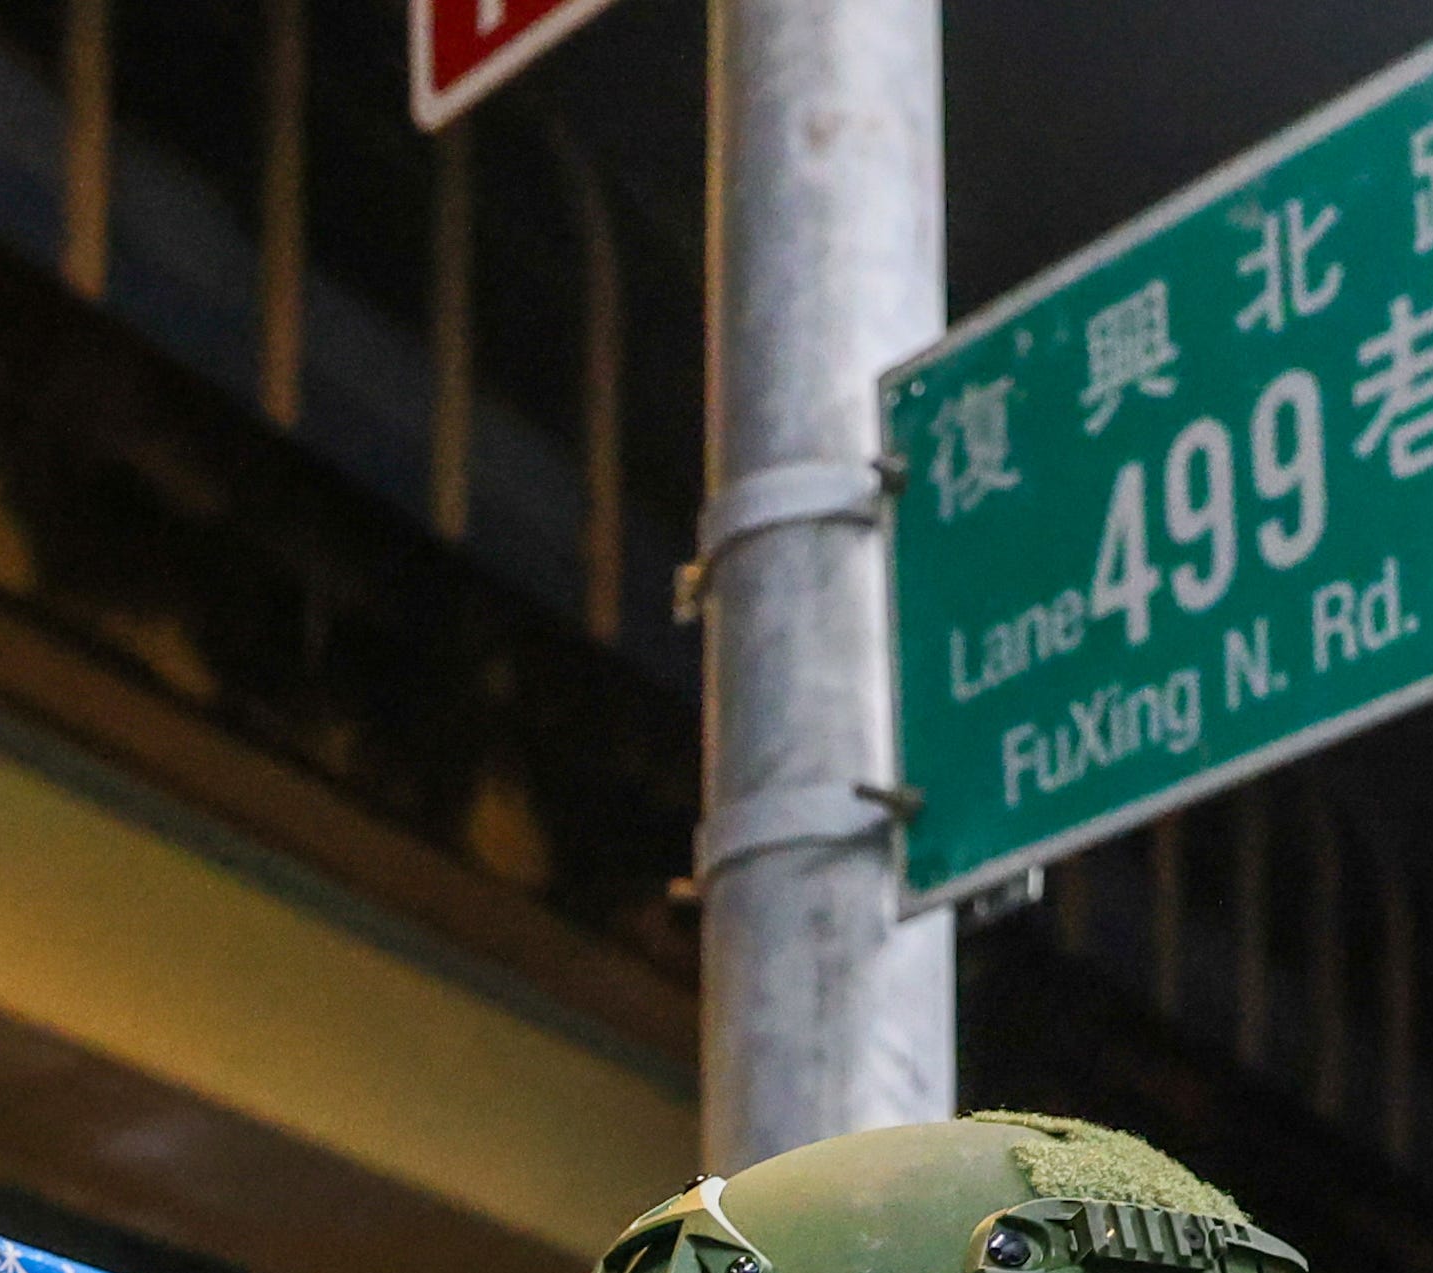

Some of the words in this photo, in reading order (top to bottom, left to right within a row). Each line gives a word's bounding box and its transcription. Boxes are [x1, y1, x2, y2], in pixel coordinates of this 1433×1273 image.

[948, 588, 1087, 702] Lane
[1001, 667, 1201, 809] FuXing
[1223, 615, 1291, 712] N.
[1312, 555, 1420, 674] Rd.
